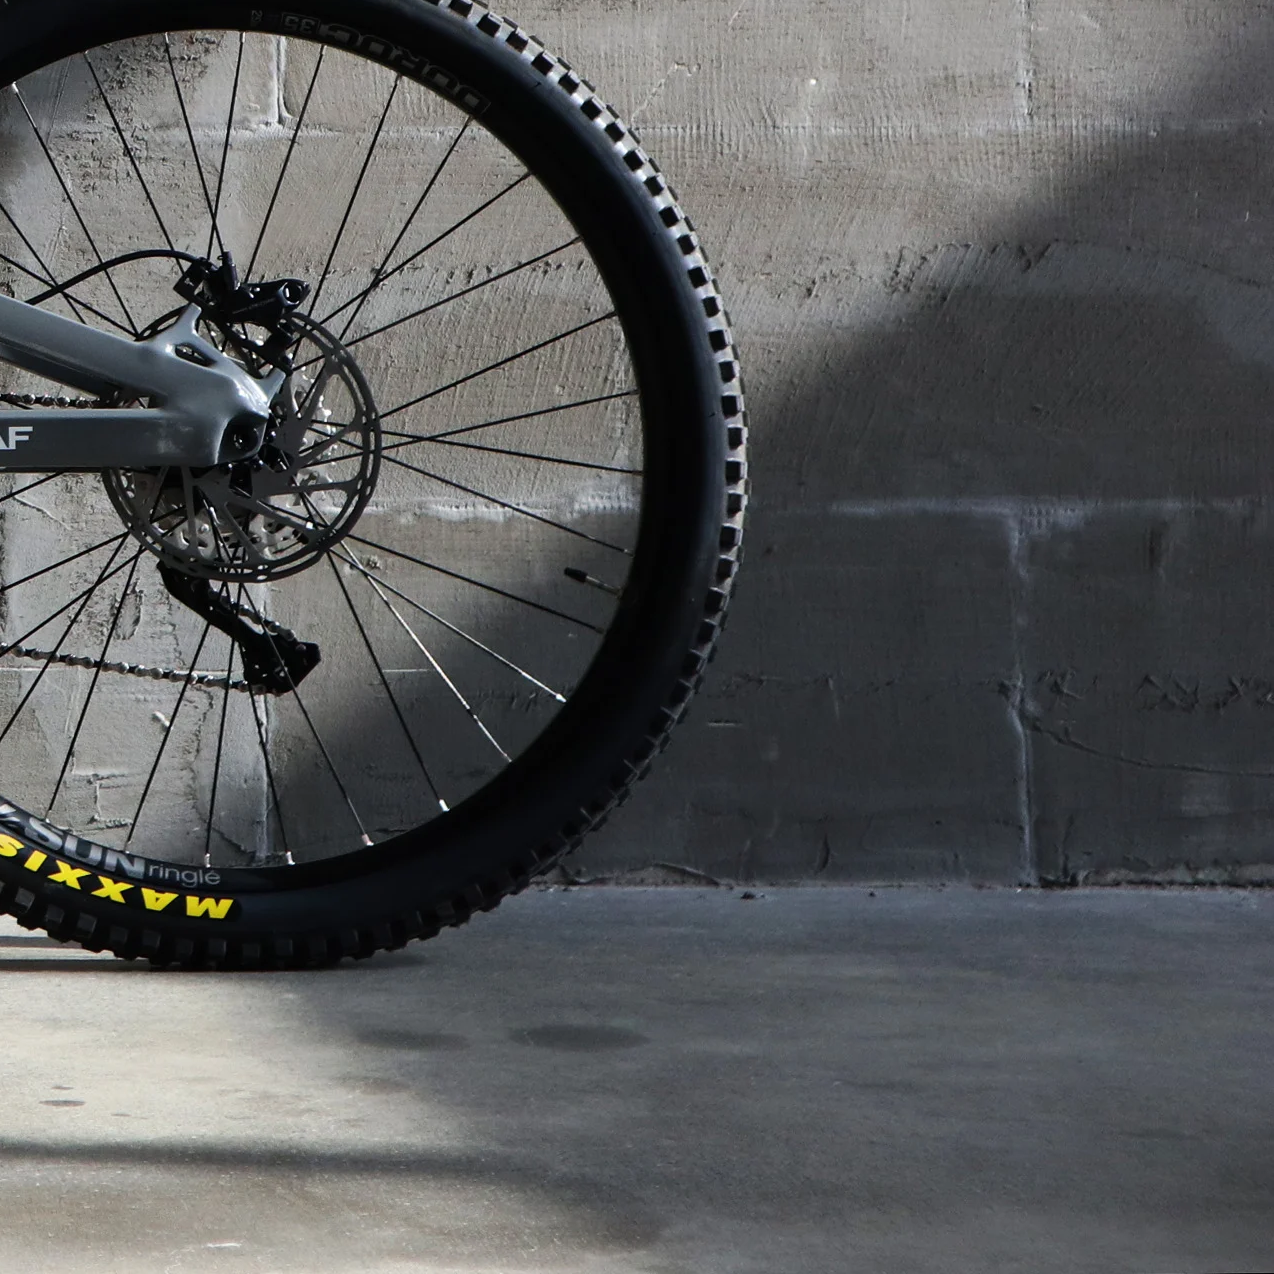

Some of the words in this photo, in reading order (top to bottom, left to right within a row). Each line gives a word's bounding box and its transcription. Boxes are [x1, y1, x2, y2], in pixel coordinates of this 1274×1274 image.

[283, 15, 316, 33] 35
[23, 817, 147, 880] SUN
[149, 863, 221, 890] ringlé
